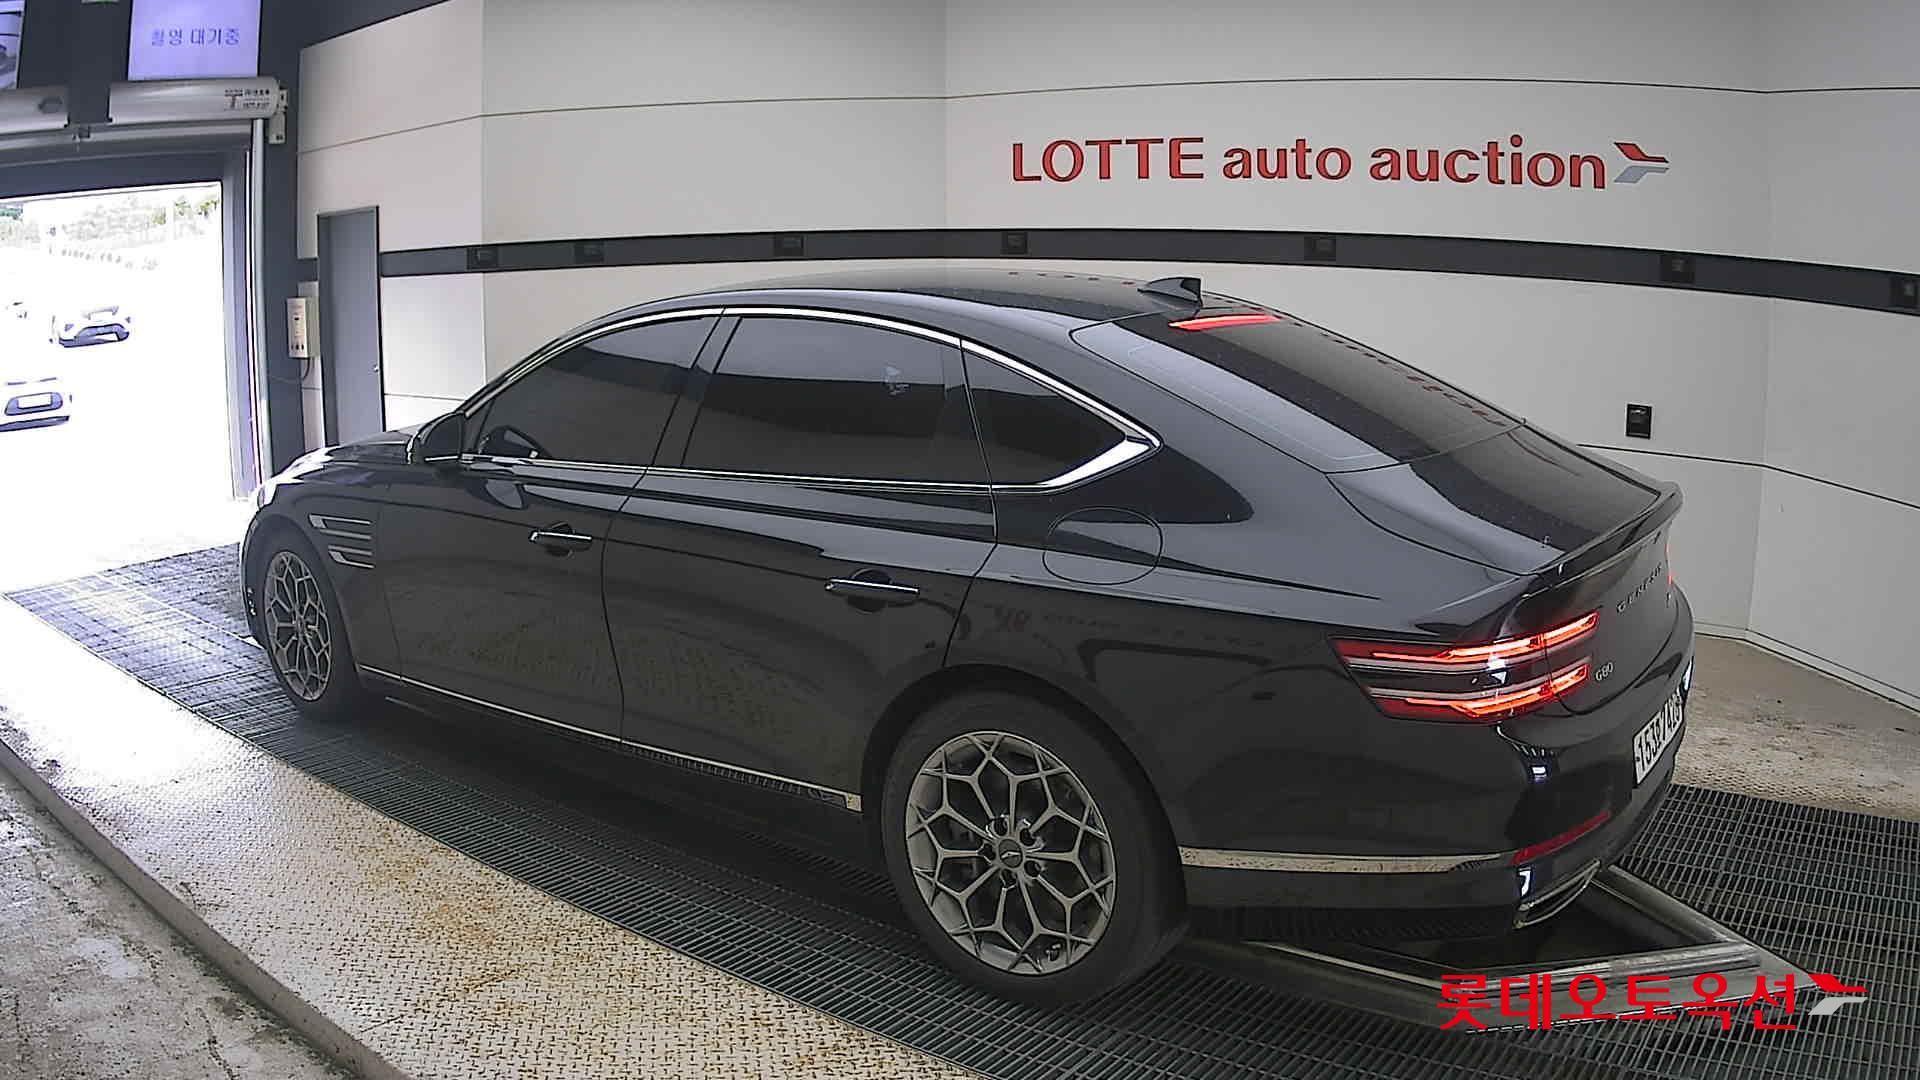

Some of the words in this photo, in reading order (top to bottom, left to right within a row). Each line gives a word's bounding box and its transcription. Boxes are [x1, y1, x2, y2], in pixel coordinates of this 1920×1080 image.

[190, 28, 240, 46] 대기중
[1012, 136, 1204, 182] LOTTE
[1222, 137, 1352, 181] auto
[1369, 134, 1606, 189] auction
[1595, 662, 1614, 682] G80
